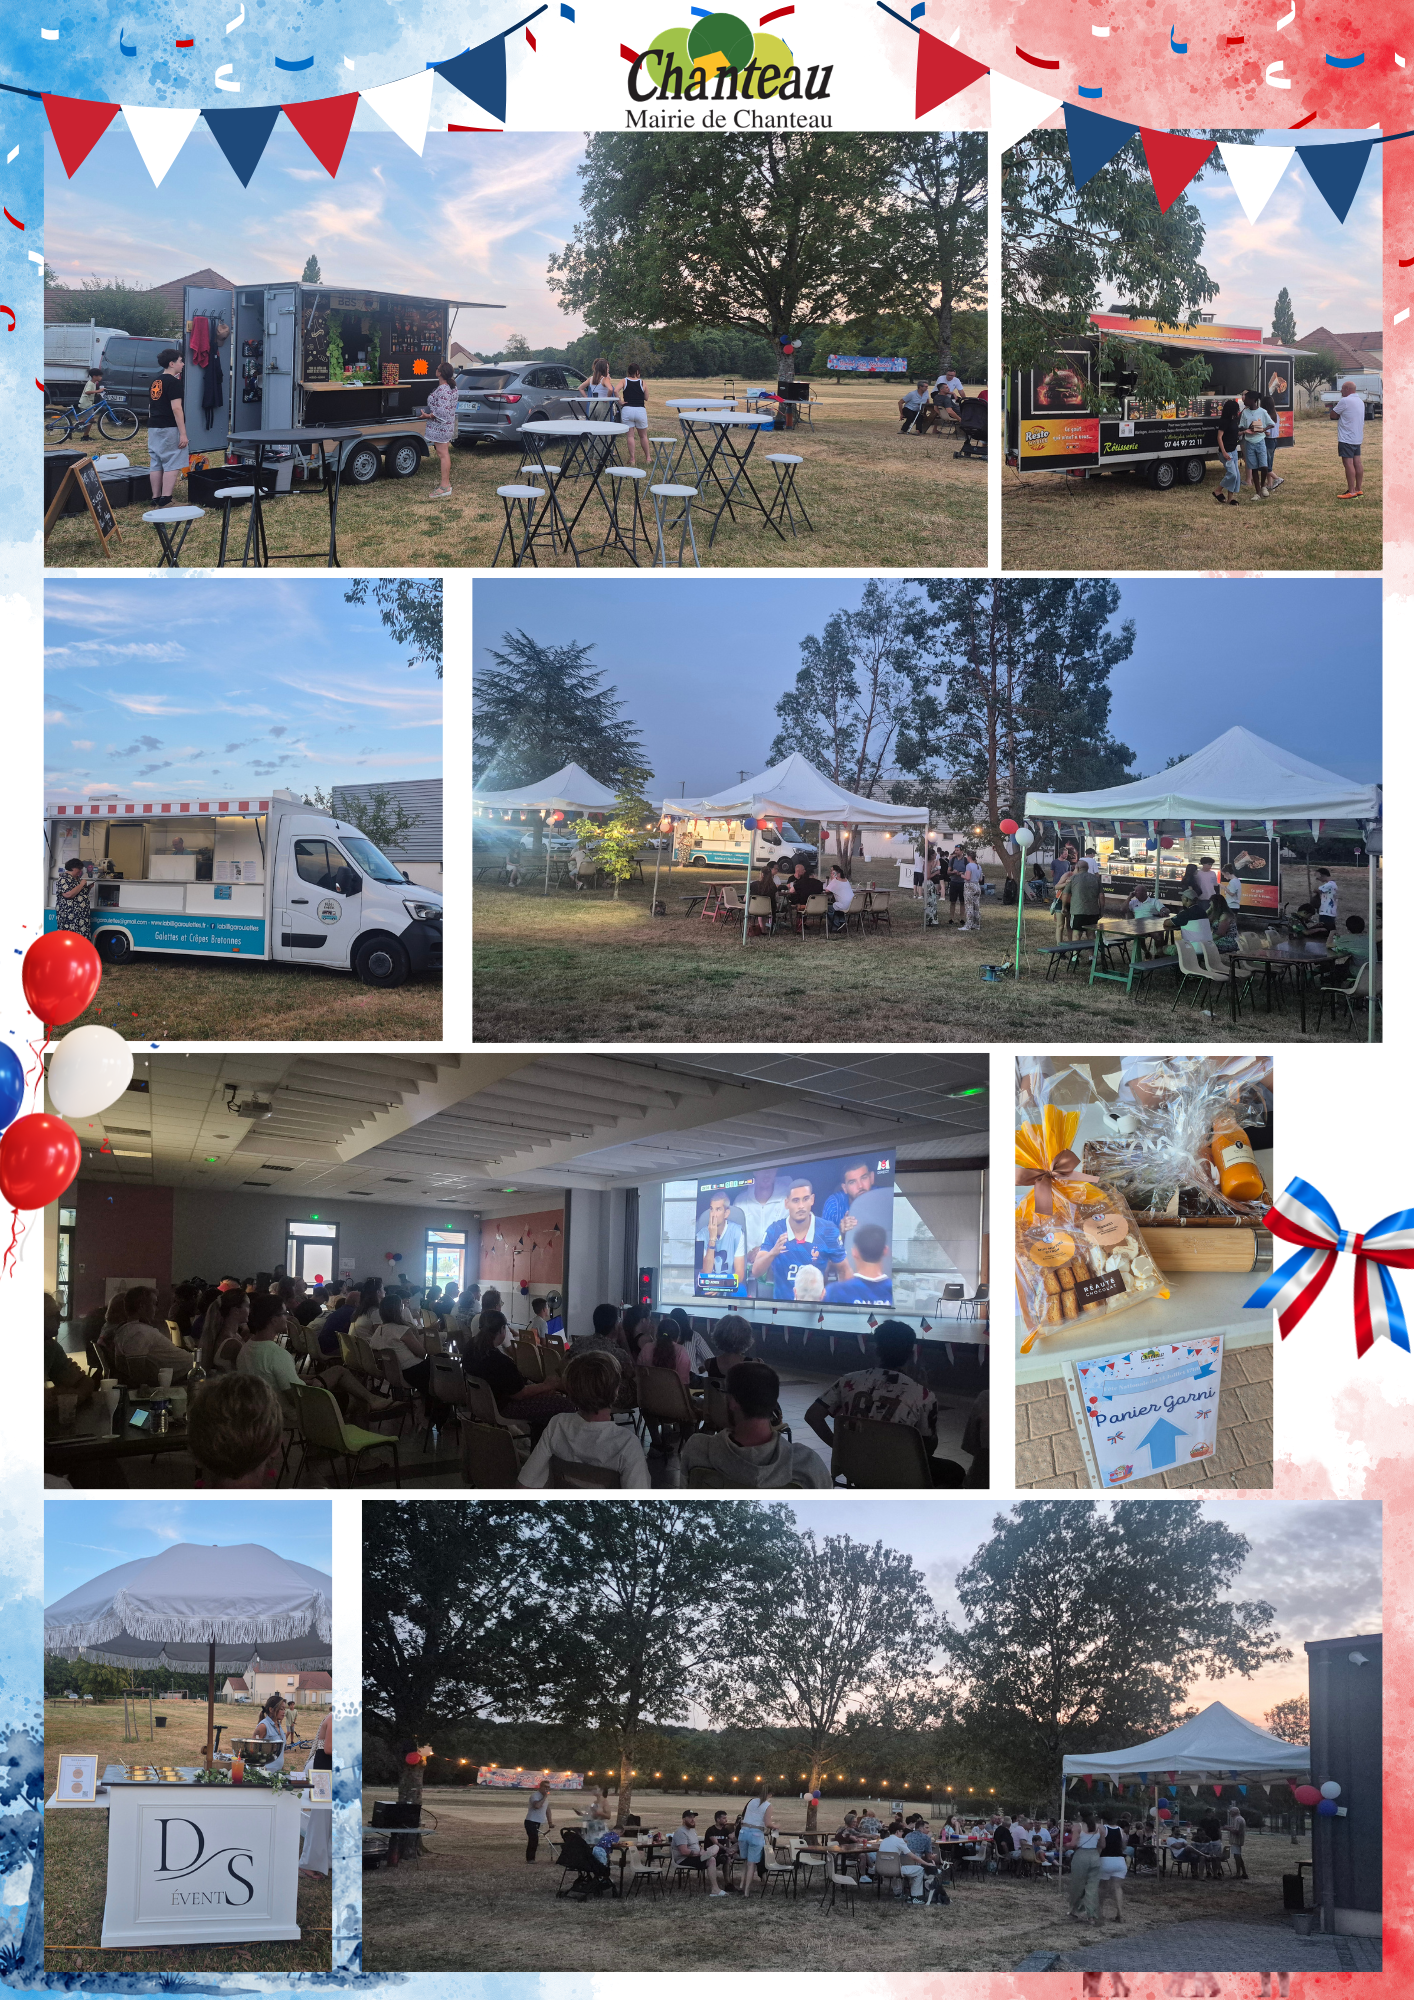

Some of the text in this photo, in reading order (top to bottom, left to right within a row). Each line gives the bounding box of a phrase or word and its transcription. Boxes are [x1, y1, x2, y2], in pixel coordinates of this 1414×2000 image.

[1025, 430, 1050, 442] Resto
[1181, 439, 1188, 447] 97
[1103, 442, 1139, 454] Rôtisserie
[155, 931, 242, 945] Galettes et Crêpes Bretonnes
[1083, 1276, 1116, 1293] RÉAUTÉ
[1085, 1283, 1117, 1297] CHOCOLAT
[1119, 1380, 1149, 1390] Nationale
[1167, 1370, 1186, 1379] Juillet
[1095, 1387, 1216, 1427] Panier Garni
